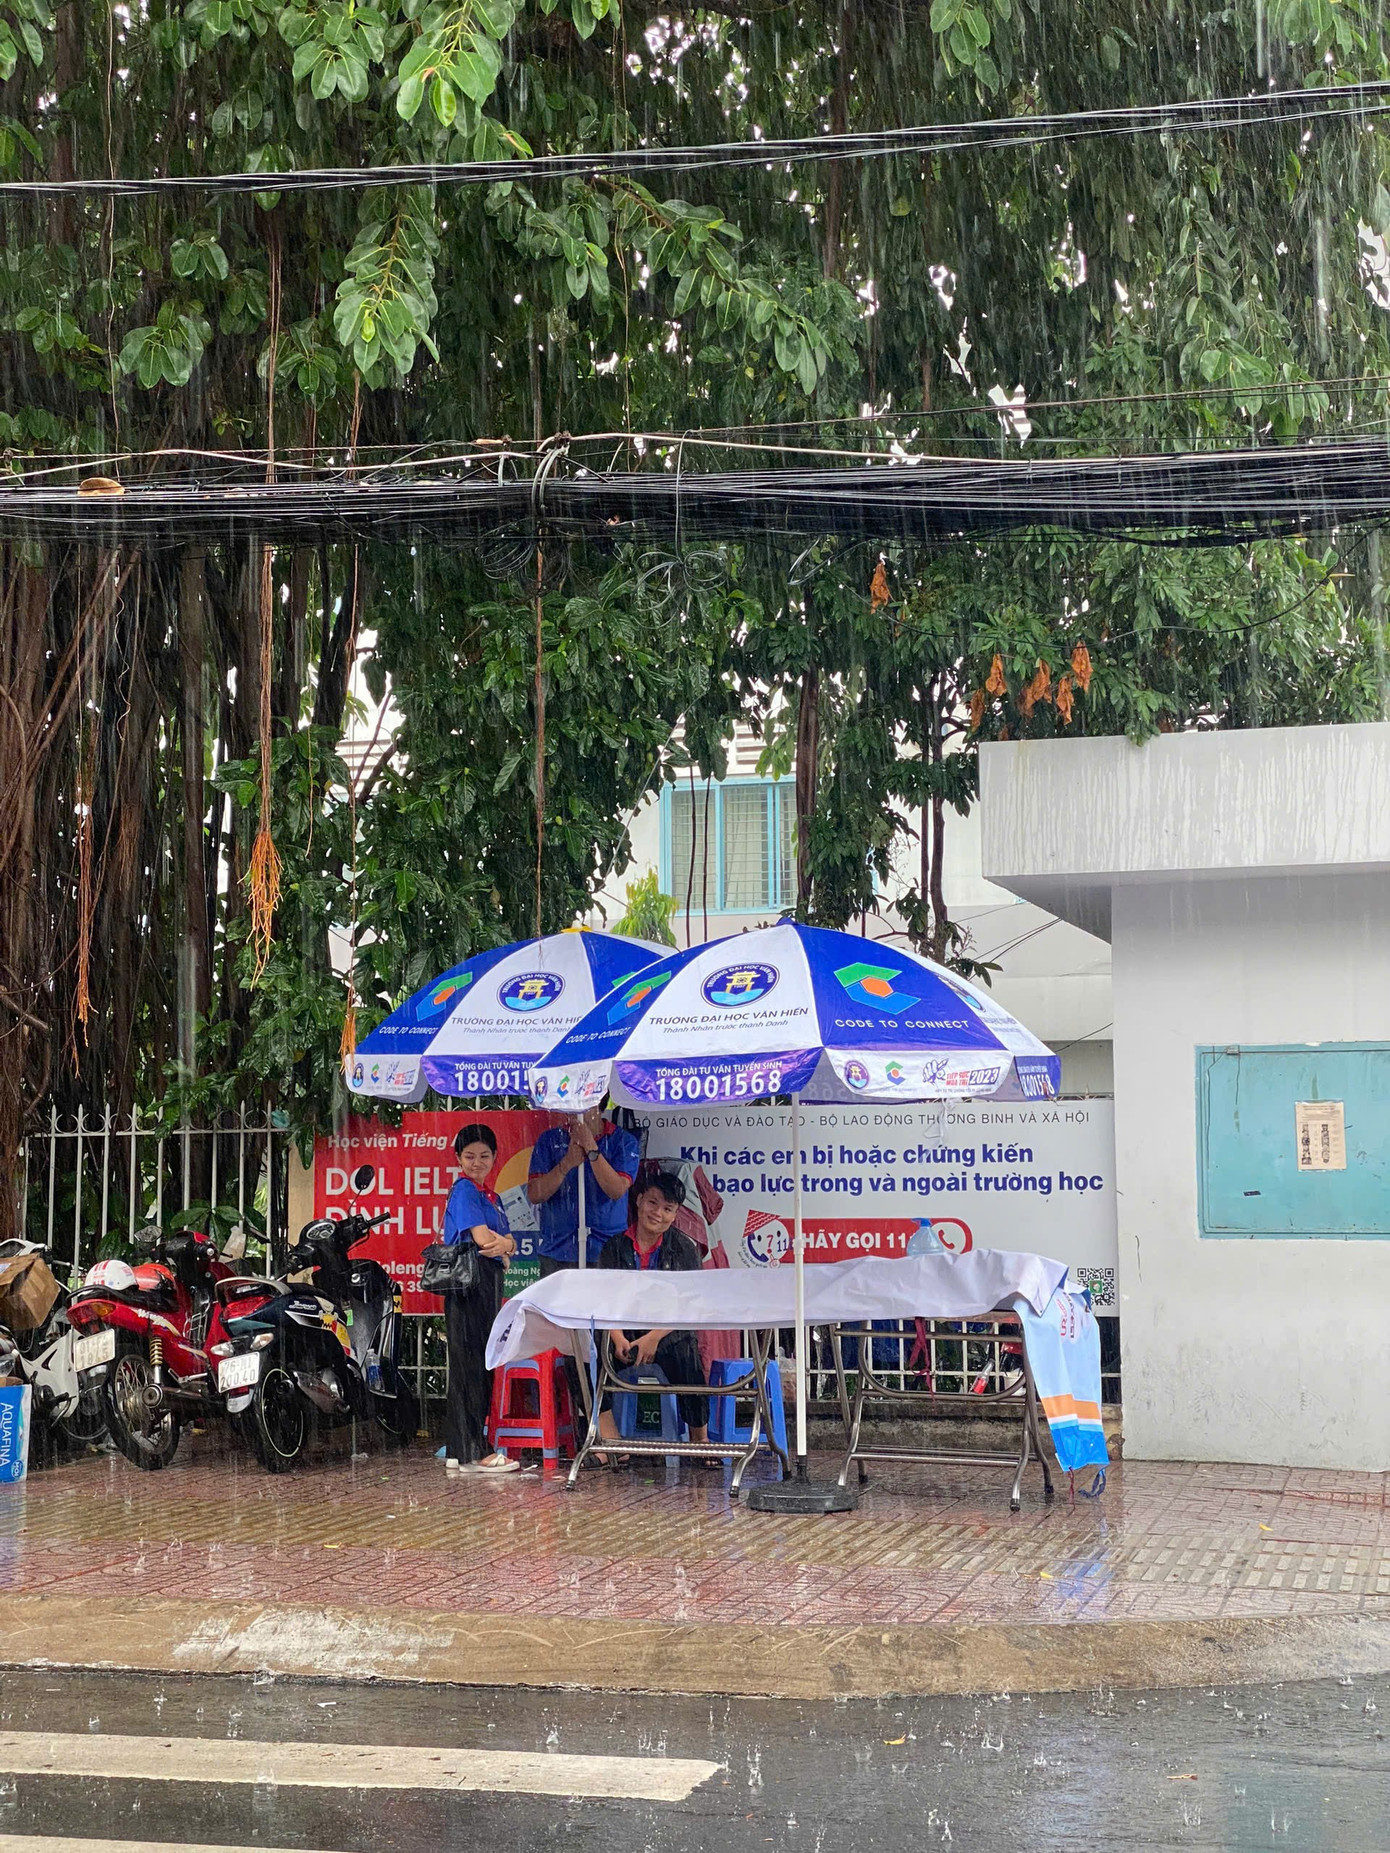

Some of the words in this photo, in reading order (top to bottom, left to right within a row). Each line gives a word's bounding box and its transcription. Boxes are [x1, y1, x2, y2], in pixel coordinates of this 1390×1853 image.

[649, 1015, 698, 1025] TRƯỜNG
[700, 1014, 721, 1024] ĐẠI
[724, 1012, 750, 1022] HỌC
[765, 1019, 789, 1027] Danh
[835, 1019, 875, 1028] CODE
[878, 1019, 898, 1028] TO
[904, 1020, 969, 1029] CONNECT
[477, 1060, 491, 1070] ĐÀI
[655, 1066, 680, 1077] TỔNG
[682, 1065, 697, 1076] ĐÀI
[762, 1060, 783, 1070] SINH
[655, 1069, 781, 1101] 18001568
[969, 1068, 999, 1084] 2023
[656, 1116, 688, 1128] GIÁO
[692, 1117, 720, 1129] DỤC
[725, 1114, 742, 1127] VÀ
[746, 1114, 774, 1127] ĐÀO
[819, 1113, 838, 1128] BỘ
[843, 1114, 869, 1126] LAO
[874, 1113, 913, 1128] ĐỘNG
[981, 1113, 1014, 1124] BINH
[1019, 1111, 1037, 1123] VÀ
[1042, 1110, 1060, 1123] XÃ
[1065, 1109, 1089, 1125] HỘI
[328, 1134, 360, 1152] Học
[363, 1133, 398, 1151] viện
[402, 1131, 448, 1151] Tiếng
[680, 1146, 718, 1165] Khi
[723, 1146, 766, 1165] các
[812, 1145, 833, 1168] bị
[839, 1145, 897, 1168] hoặc
[903, 1144, 976, 1168] chứng
[982, 1142, 1034, 1164] kiến
[325, 1166, 394, 1196] DOL
[404, 1166, 463, 1196] IELT
[712, 1174, 755, 1197] bạo
[760, 1173, 795, 1197] lực
[801, 1174, 863, 1197] trong
[868, 1173, 896, 1193] và
[902, 1171, 967, 1196] ngoài
[973, 1172, 1053, 1196] trường
[1058, 1171, 1104, 1196] học
[801, 1229, 842, 1249] HÃY
[845, 1232, 881, 1252] GỌI
[886, 1232, 916, 1249] 11
[376, 1260, 426, 1278] oleng
[504, 1266, 529, 1277] oàng
[0, 1402, 14, 1467] AQUAFINA
